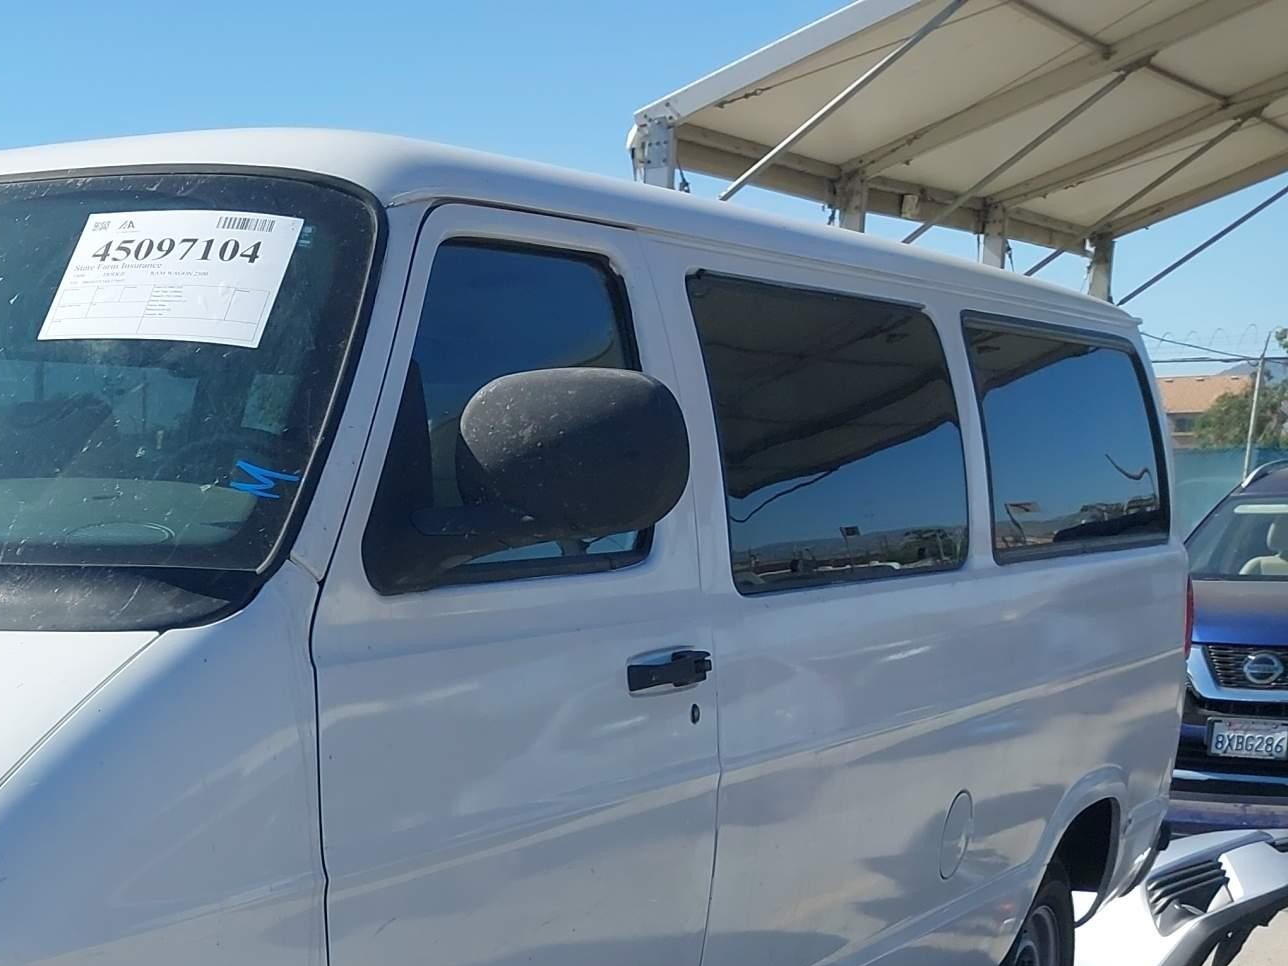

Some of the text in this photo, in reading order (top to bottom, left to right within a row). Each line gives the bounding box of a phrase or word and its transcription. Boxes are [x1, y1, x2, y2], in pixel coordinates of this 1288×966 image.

[91, 237, 262, 264] 45097104
[121, 262, 163, 270] Insurance
[1214, 734, 1286, 754] 8XBG286
